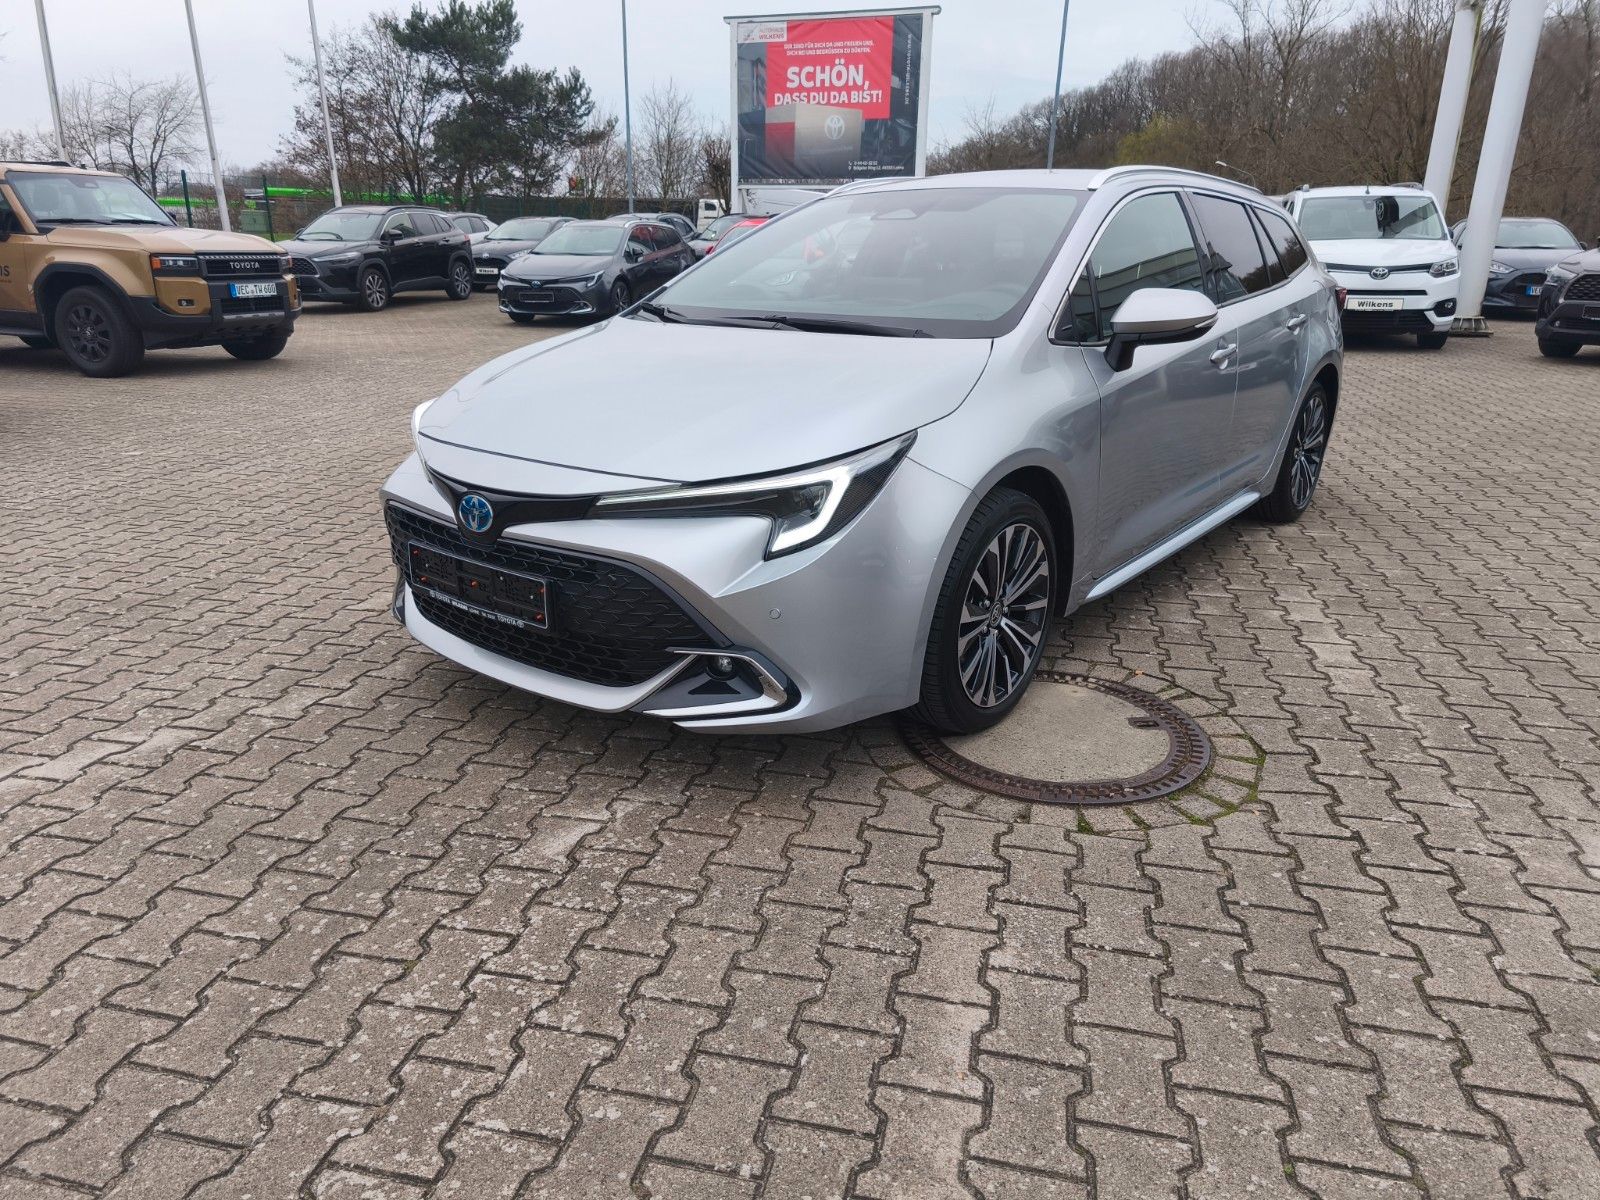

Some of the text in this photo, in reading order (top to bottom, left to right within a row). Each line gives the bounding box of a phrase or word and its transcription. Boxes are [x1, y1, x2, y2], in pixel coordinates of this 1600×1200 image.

[786, 58, 869, 90] SCHÖN,
[774, 90, 882, 106] DASS DU DA BIST!
[497, 614, 517, 626] TOYOTA
